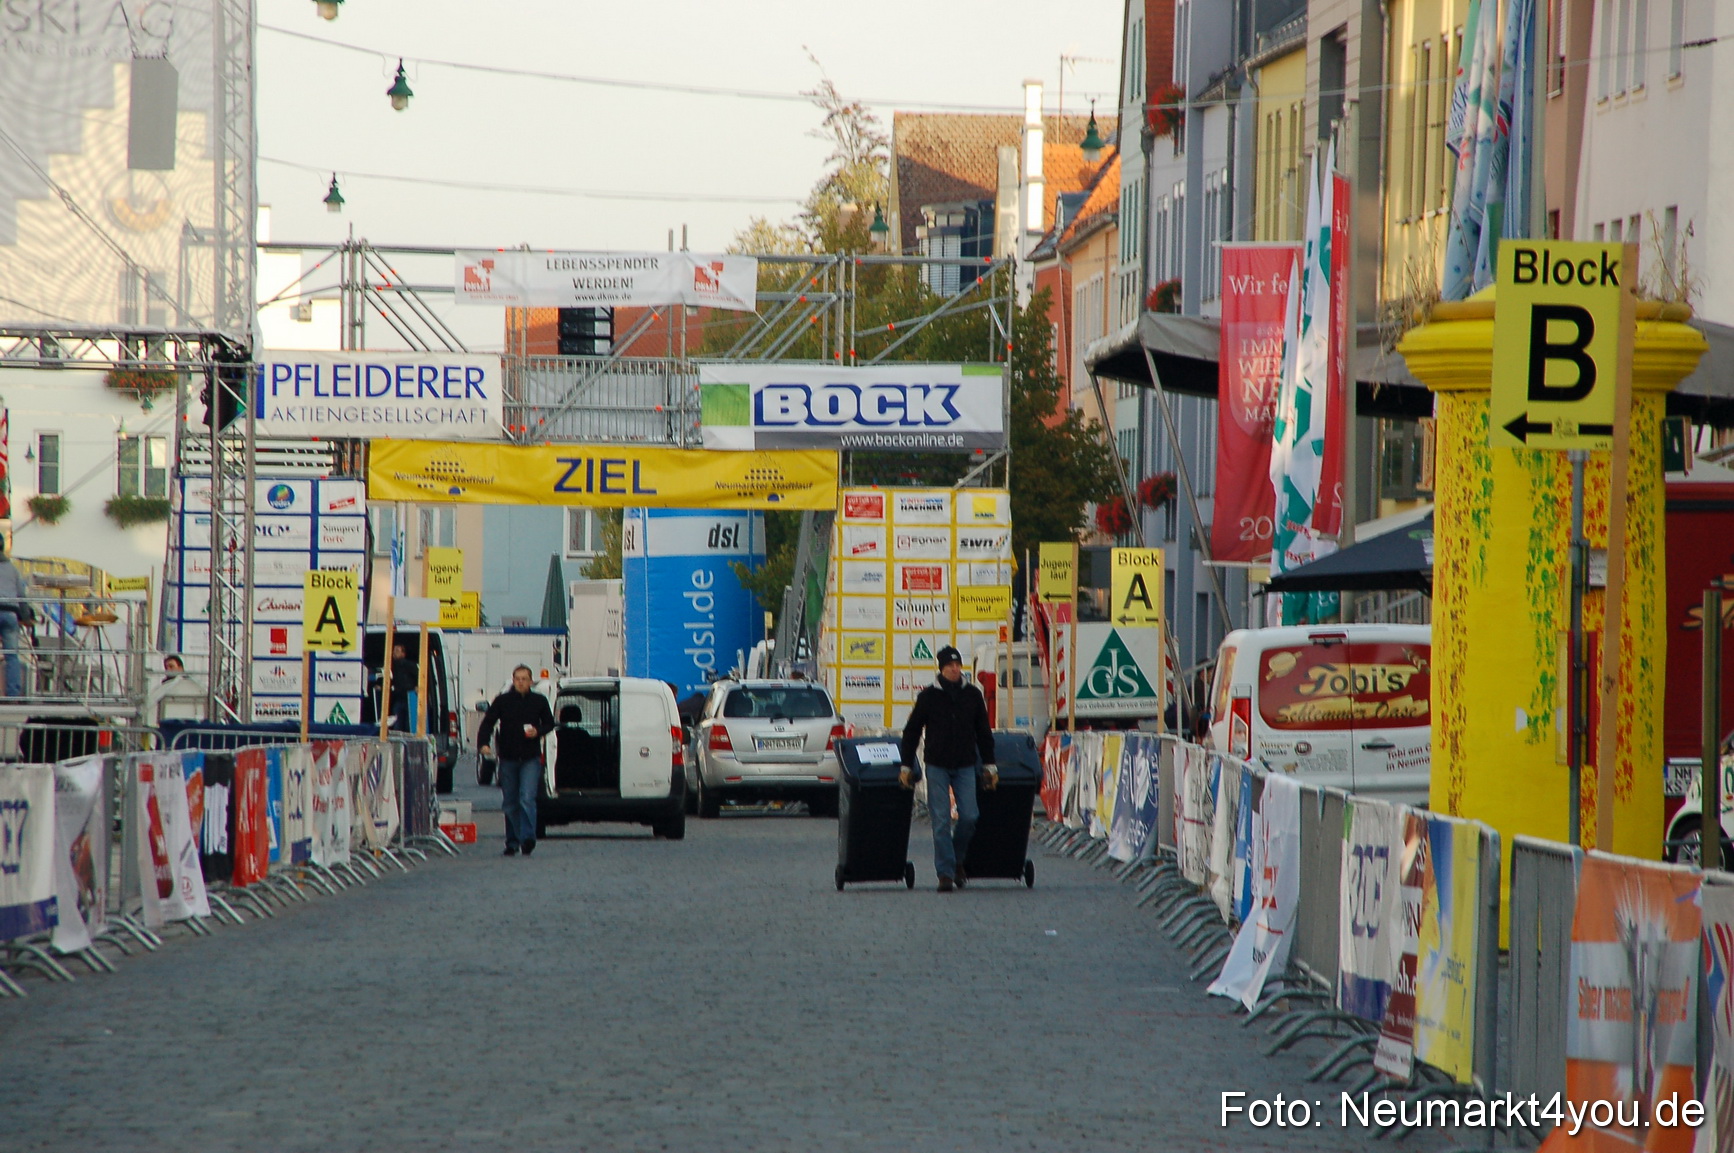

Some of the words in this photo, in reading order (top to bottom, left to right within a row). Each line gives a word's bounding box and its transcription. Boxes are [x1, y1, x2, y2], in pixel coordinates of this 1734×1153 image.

[546, 257, 660, 271] LEBENSSPENDER
[1513, 248, 1621, 287] Block
[572, 276, 634, 290] WERDEN!
[1229, 275, 1265, 296] Wir
[1271, 272, 1288, 295] fe
[575, 292, 632, 302] www.dkms.de
[1241, 338, 1283, 355] IMM
[1527, 303, 1598, 402] B
[1238, 358, 1283, 376] WIE
[272, 363, 488, 399] PFLEIDERER
[754, 384, 961, 426] BOCK
[271, 406, 489, 424] AKTIENGESELLSCHAFT
[840, 433, 964, 447] www.bockonline.de
[553, 457, 657, 495] ZIEL
[715, 481, 768, 490] Neumarkter
[771, 481, 814, 491] Stadtlauf
[708, 522, 739, 549] dsl
[1239, 516, 1274, 541] 20
[1118, 552, 1160, 567] Block
[430, 565, 461, 574] ugend-
[1050, 570, 1068, 580] lauf
[311, 574, 353, 589] Block
[1123, 573, 1153, 610] A
[315, 595, 346, 633] A
[896, 600, 947, 614] Sinupret
[896, 617, 925, 627] fote
[1295, 664, 1407, 694] Tobi's
[1387, 750, 1406, 761] Tobi
[1408, 747, 1423, 756] am
[1386, 763, 1395, 771] in
[1397, 757, 1431, 769] Neuma
